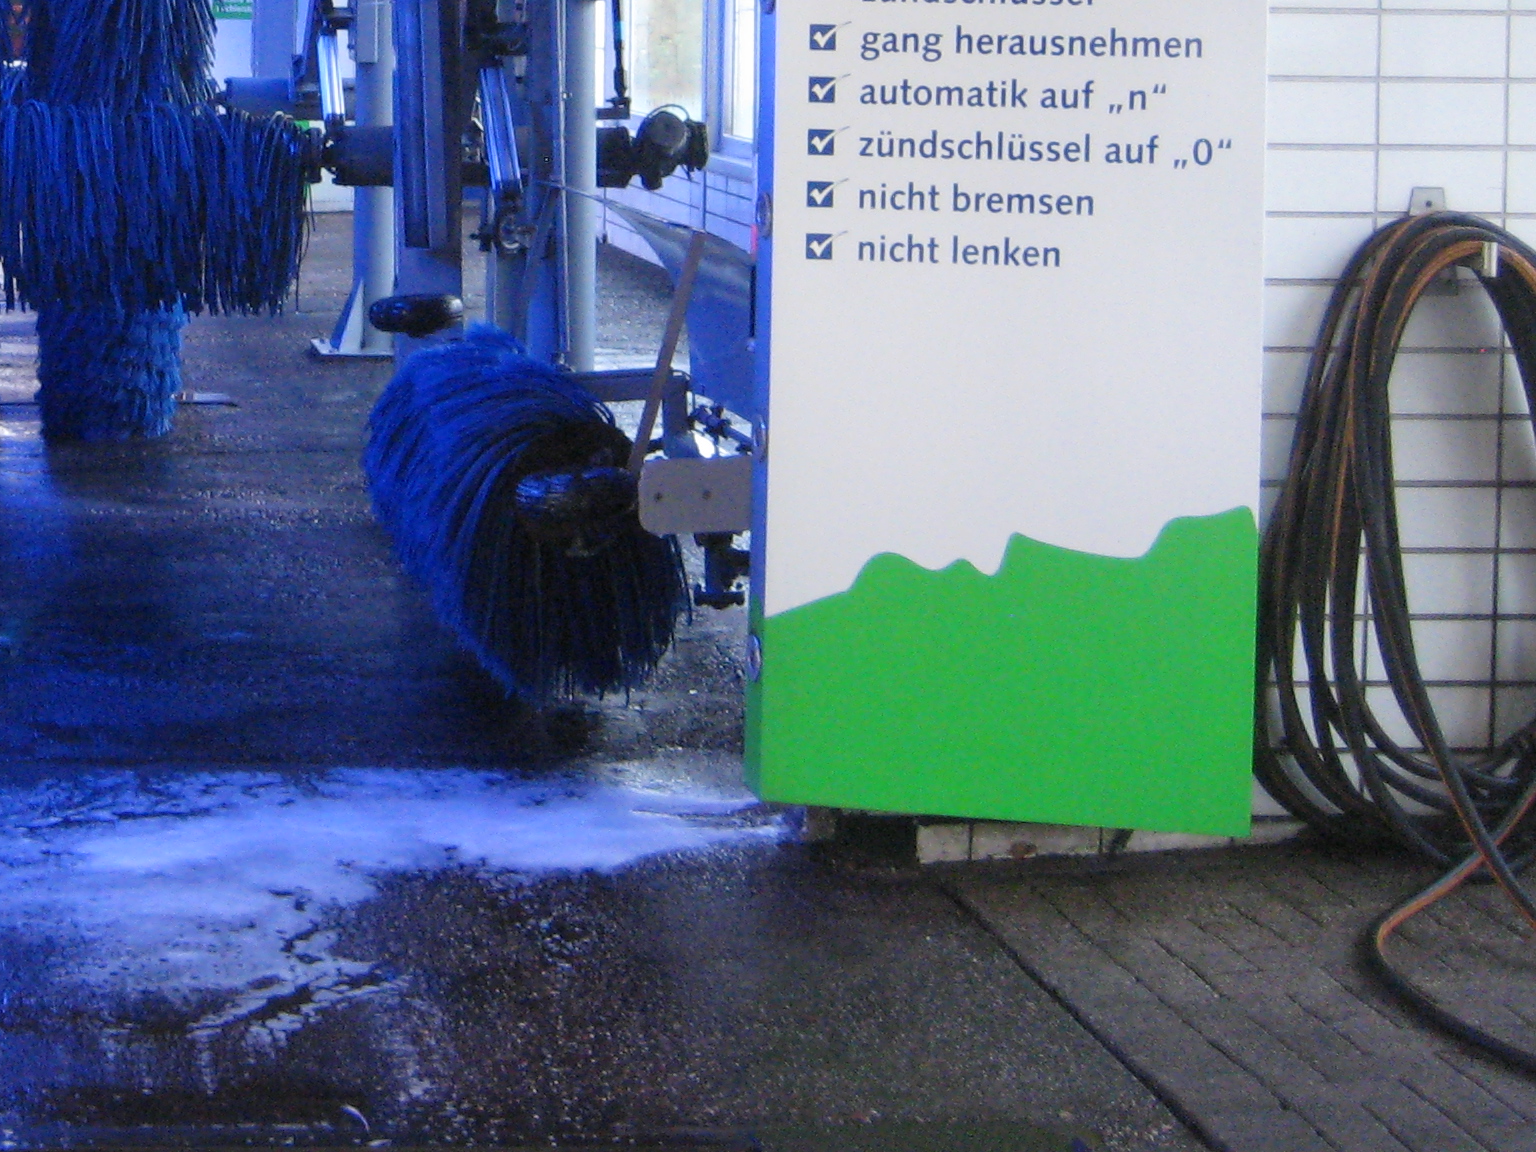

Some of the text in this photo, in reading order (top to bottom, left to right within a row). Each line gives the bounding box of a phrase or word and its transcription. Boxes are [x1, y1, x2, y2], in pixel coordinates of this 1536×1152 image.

[861, 25, 1202, 62] gang herausnehmen
[860, 79, 1027, 108] automatik
[1041, 80, 1094, 109] auf
[860, 130, 1090, 162] zündschlüssel
[1105, 135, 1158, 164] auf
[859, 182, 1093, 215] nicht bremsen
[859, 234, 1060, 267] nicht lenken
